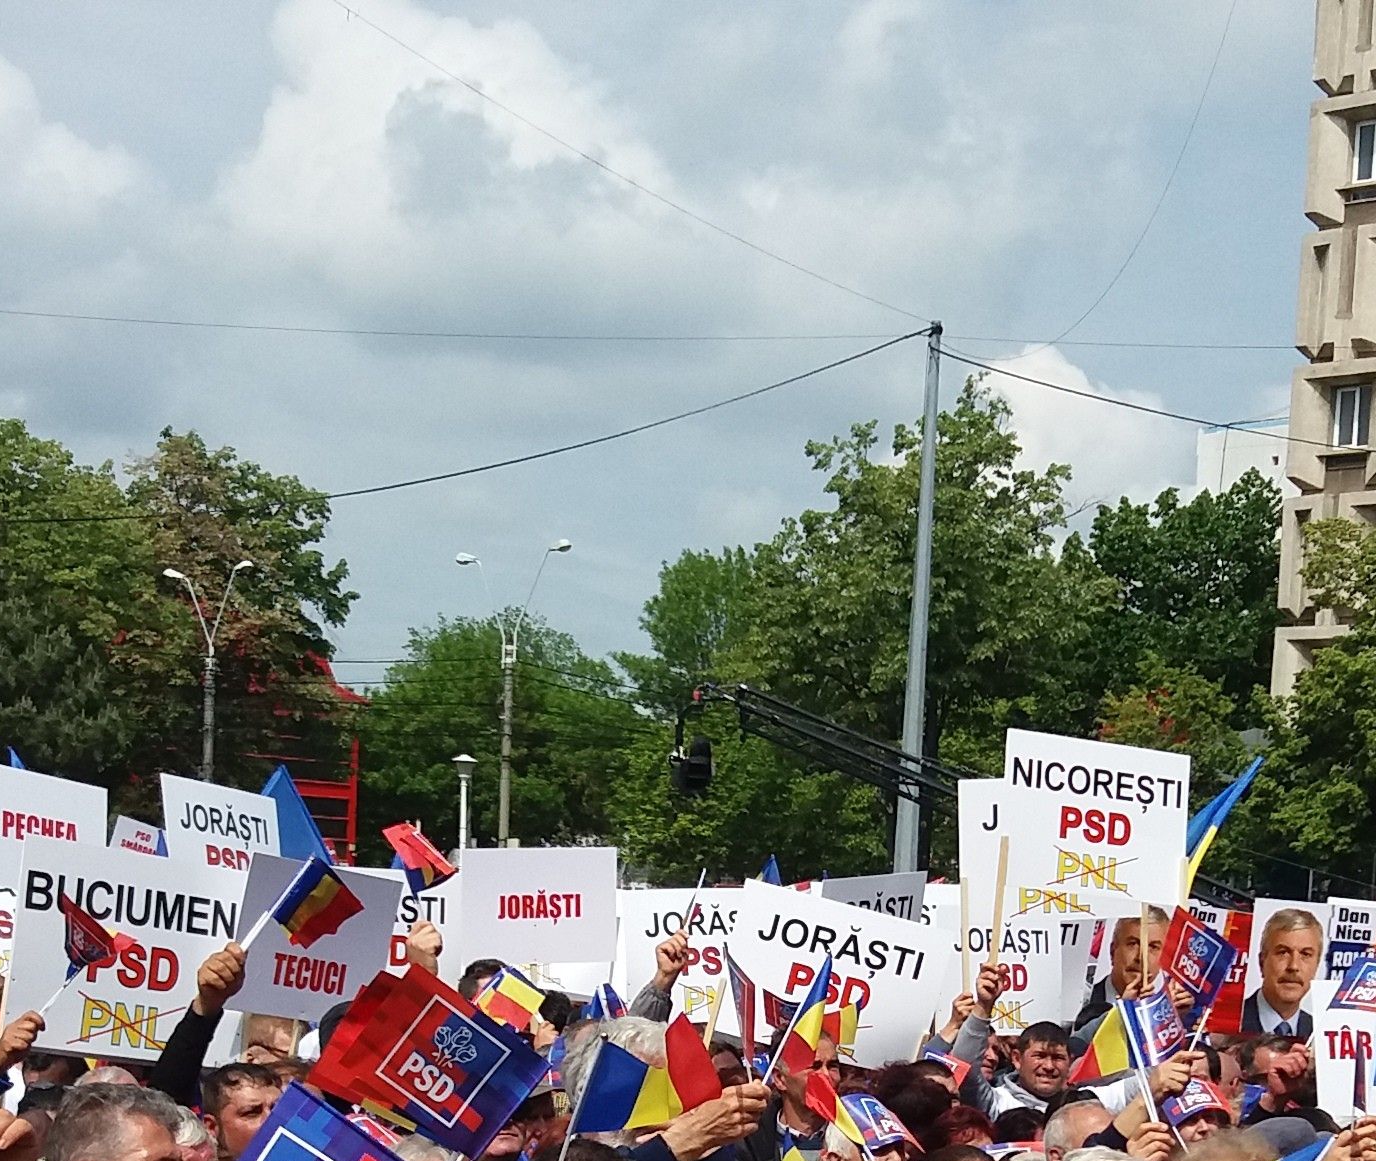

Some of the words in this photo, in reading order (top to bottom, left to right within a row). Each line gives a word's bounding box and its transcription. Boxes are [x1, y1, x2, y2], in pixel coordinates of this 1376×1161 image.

[1012, 757, 1183, 813] NICOREȘTI
[180, 801, 269, 850] JORĂȘTI
[1059, 805, 1132, 847] PSD
[1056, 849, 1129, 892] PNL
[397, 895, 446, 933] ȘTI
[497, 888, 582, 925] JORĂȘTI
[1338, 907, 1371, 925] Dan
[758, 914, 925, 980] JORĂȘTI
[1335, 924, 1372, 942] Nica
[272, 952, 347, 996] TECUCI
[996, 963, 1029, 992] SD
[1177, 953, 1203, 982] PSD
[79, 998, 168, 1051] PNL
[398, 1051, 455, 1103] PSD
[1183, 1091, 1212, 1106] PSD
